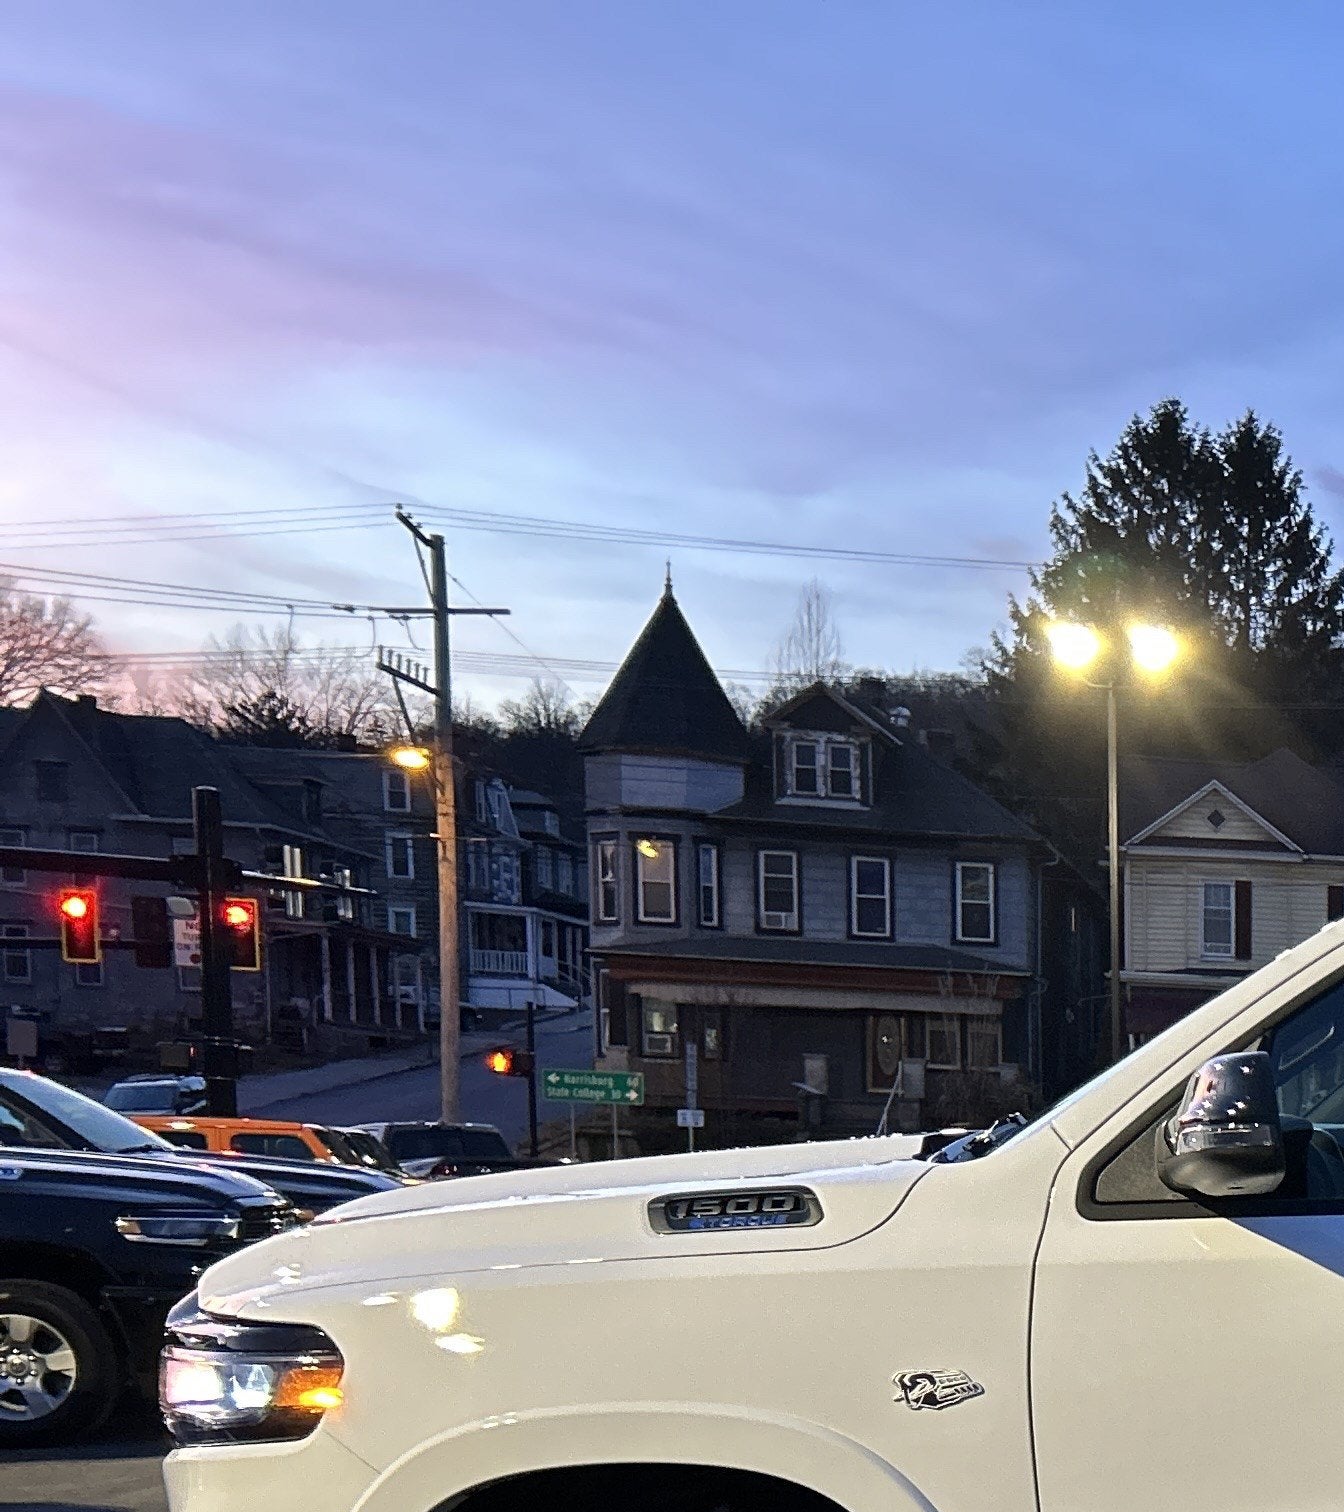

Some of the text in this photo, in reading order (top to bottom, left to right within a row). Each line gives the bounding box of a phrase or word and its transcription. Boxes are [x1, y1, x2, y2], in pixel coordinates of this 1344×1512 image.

[547, 1086, 569, 1097] State
[572, 1087, 606, 1100] College
[672, 1195, 795, 1219] 1500
